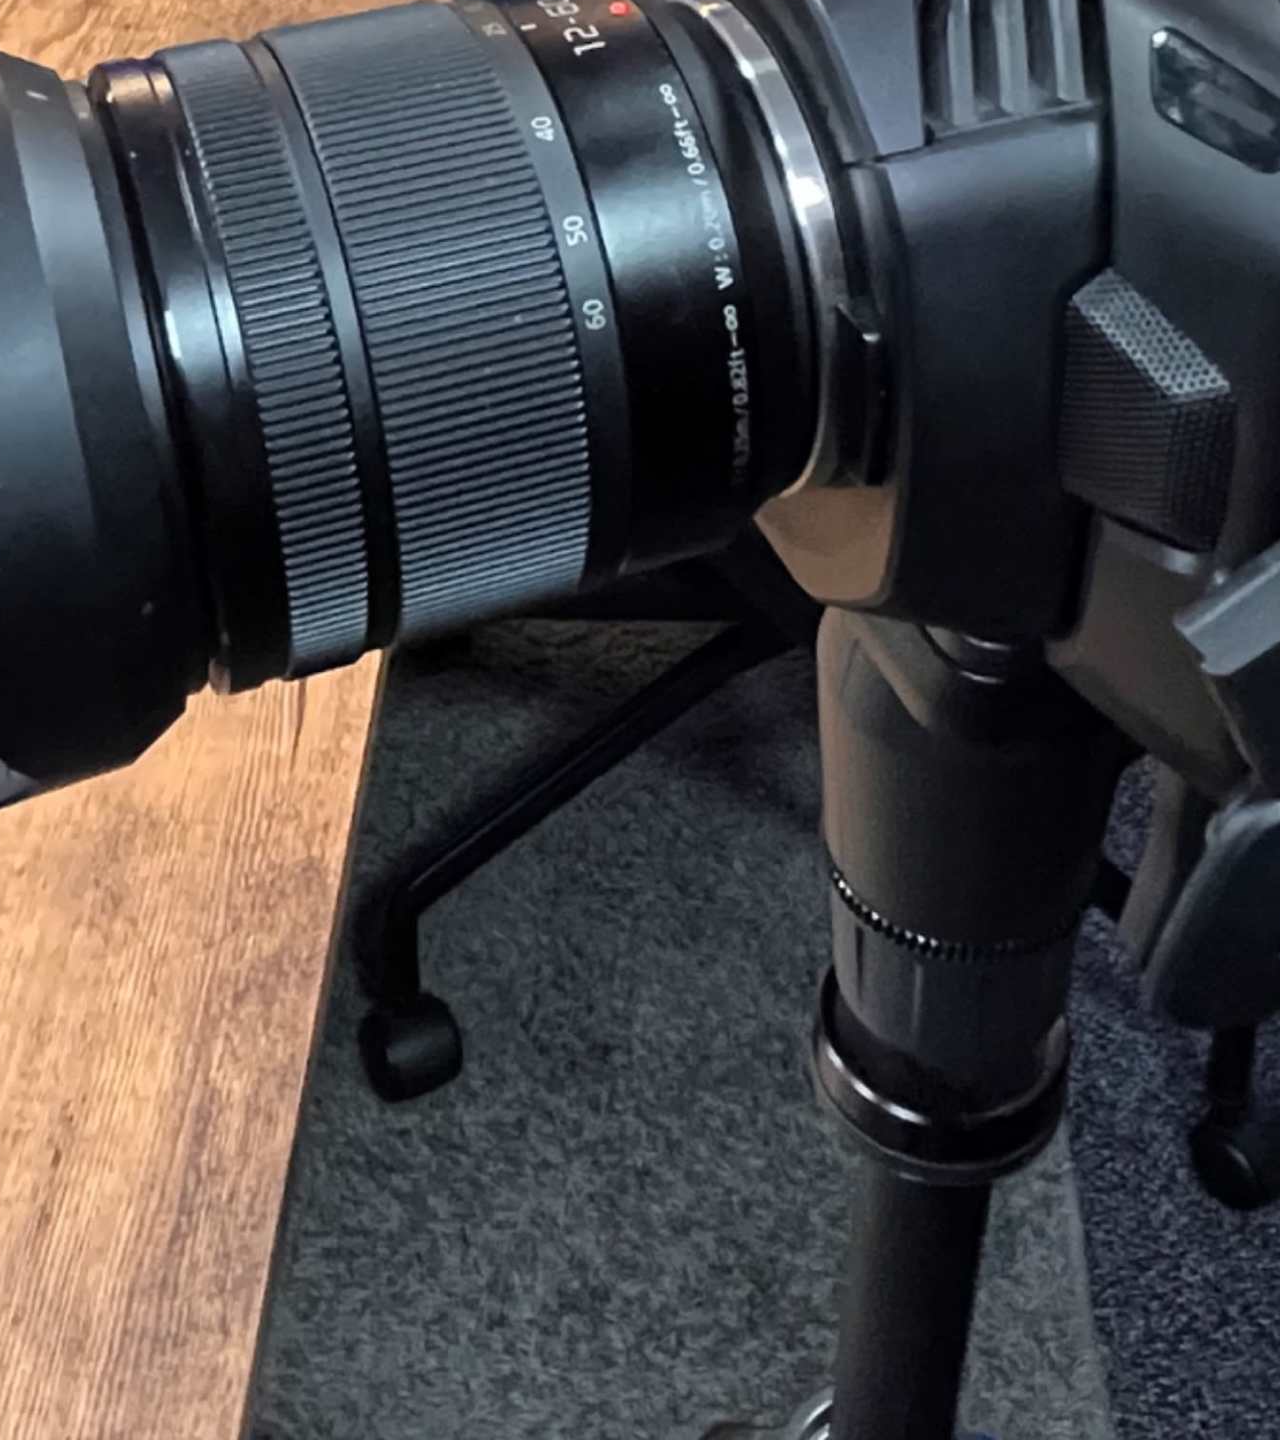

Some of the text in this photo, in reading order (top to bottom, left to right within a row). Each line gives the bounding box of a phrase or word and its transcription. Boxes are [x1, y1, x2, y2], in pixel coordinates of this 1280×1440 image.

[531, 116, 555, 141] 40
[563, 216, 588, 246] 50
[582, 298, 606, 330] 60
